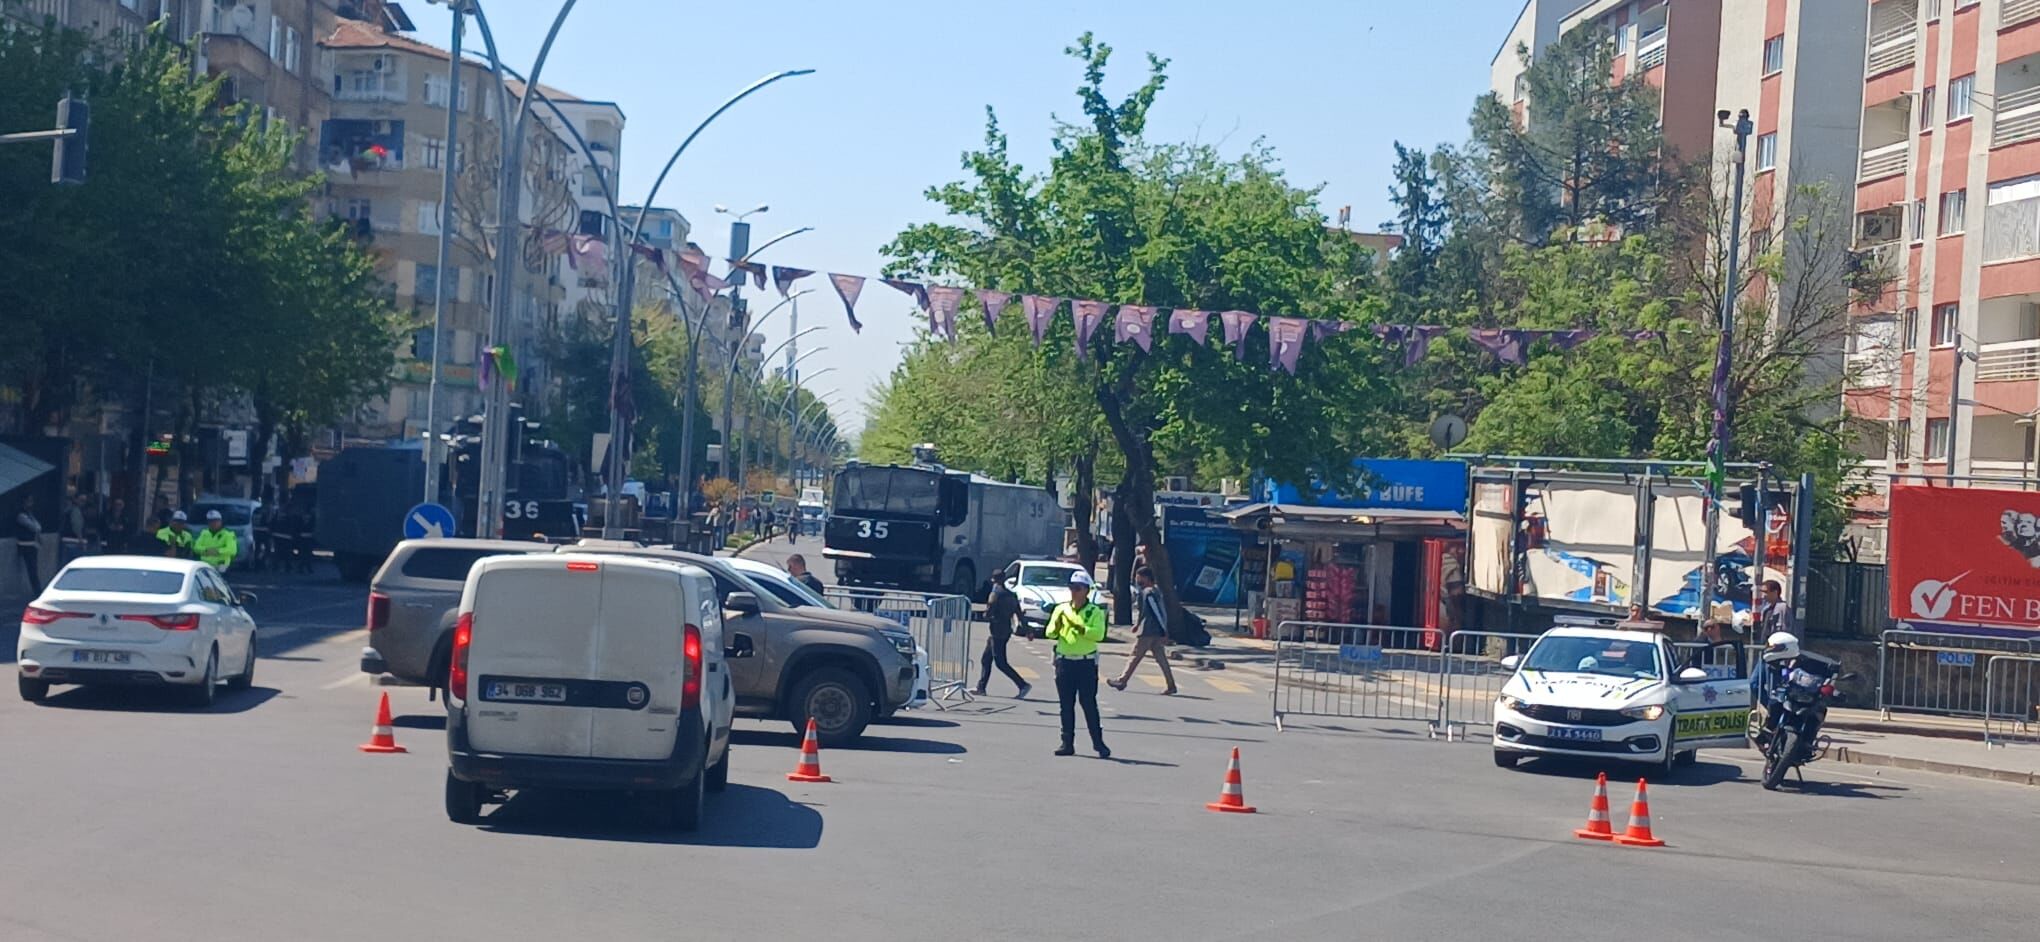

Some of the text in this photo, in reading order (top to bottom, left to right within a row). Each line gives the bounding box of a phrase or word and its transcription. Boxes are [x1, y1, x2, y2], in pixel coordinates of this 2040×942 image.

[1380, 482, 1424, 502] BÜFE
[505, 500, 539, 519] 36
[1030, 502, 1044, 518] 35
[857, 520, 889, 539] 35
[1960, 594, 2016, 618] FEN
[495, 683, 509, 697] 34
